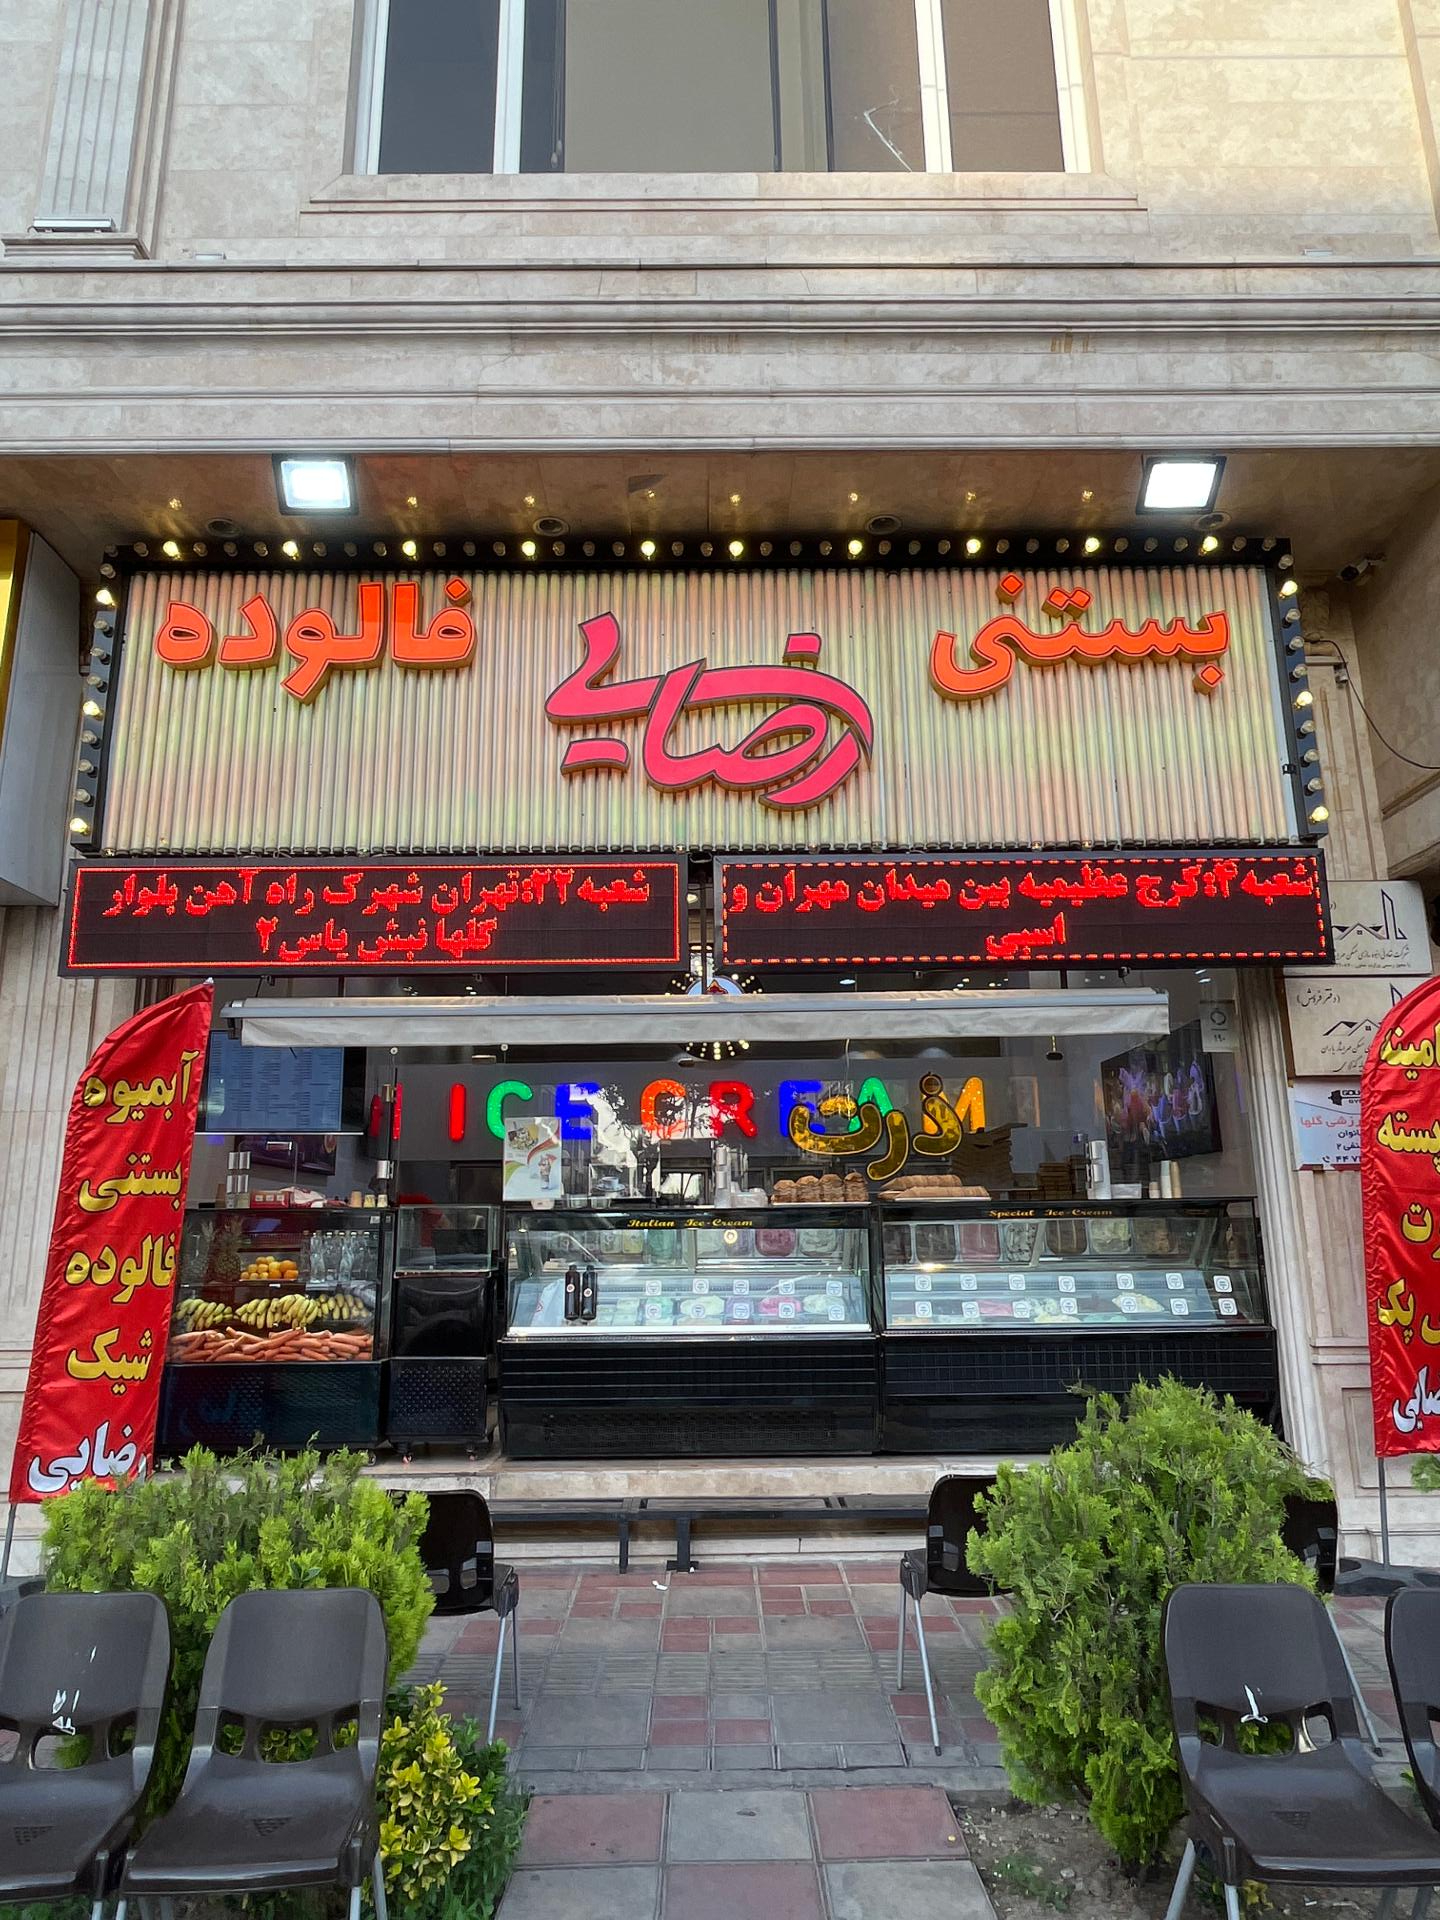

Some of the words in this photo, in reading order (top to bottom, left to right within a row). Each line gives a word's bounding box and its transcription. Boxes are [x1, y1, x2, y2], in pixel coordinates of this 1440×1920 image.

[155, 576, 476, 703] فالوده
[930, 572, 1230, 700] بستنی
[102, 874, 178, 916] بلوار
[185, 869, 260, 916] آهن
[266, 873, 315, 915] راه
[577, 869, 650, 912] شعبه
[729, 884, 748, 912] و
[756, 869, 850, 912] مهران
[857, 868, 951, 912] میدان
[959, 876, 1011, 910] بین
[1017, 864, 1129, 908] عظیمیه
[1240, 863, 1314, 906] شعبه
[278, 918, 349, 961] یاس
[357, 918, 428, 960] نبش
[83, 1050, 199, 1124] آبمیوه
[450, 1079, 602, 1143] ICE
[789, 1072, 963, 1181] ذرت
[1337, 1129, 1361, 1139] انوان
[77, 1152, 181, 1214] بستنی
[627, 1218, 675, 1228] Italian
[988, 1208, 1035, 1218] Special
[65, 1233, 176, 1304] فالوده
[67, 1327, 153, 1395] شیک
